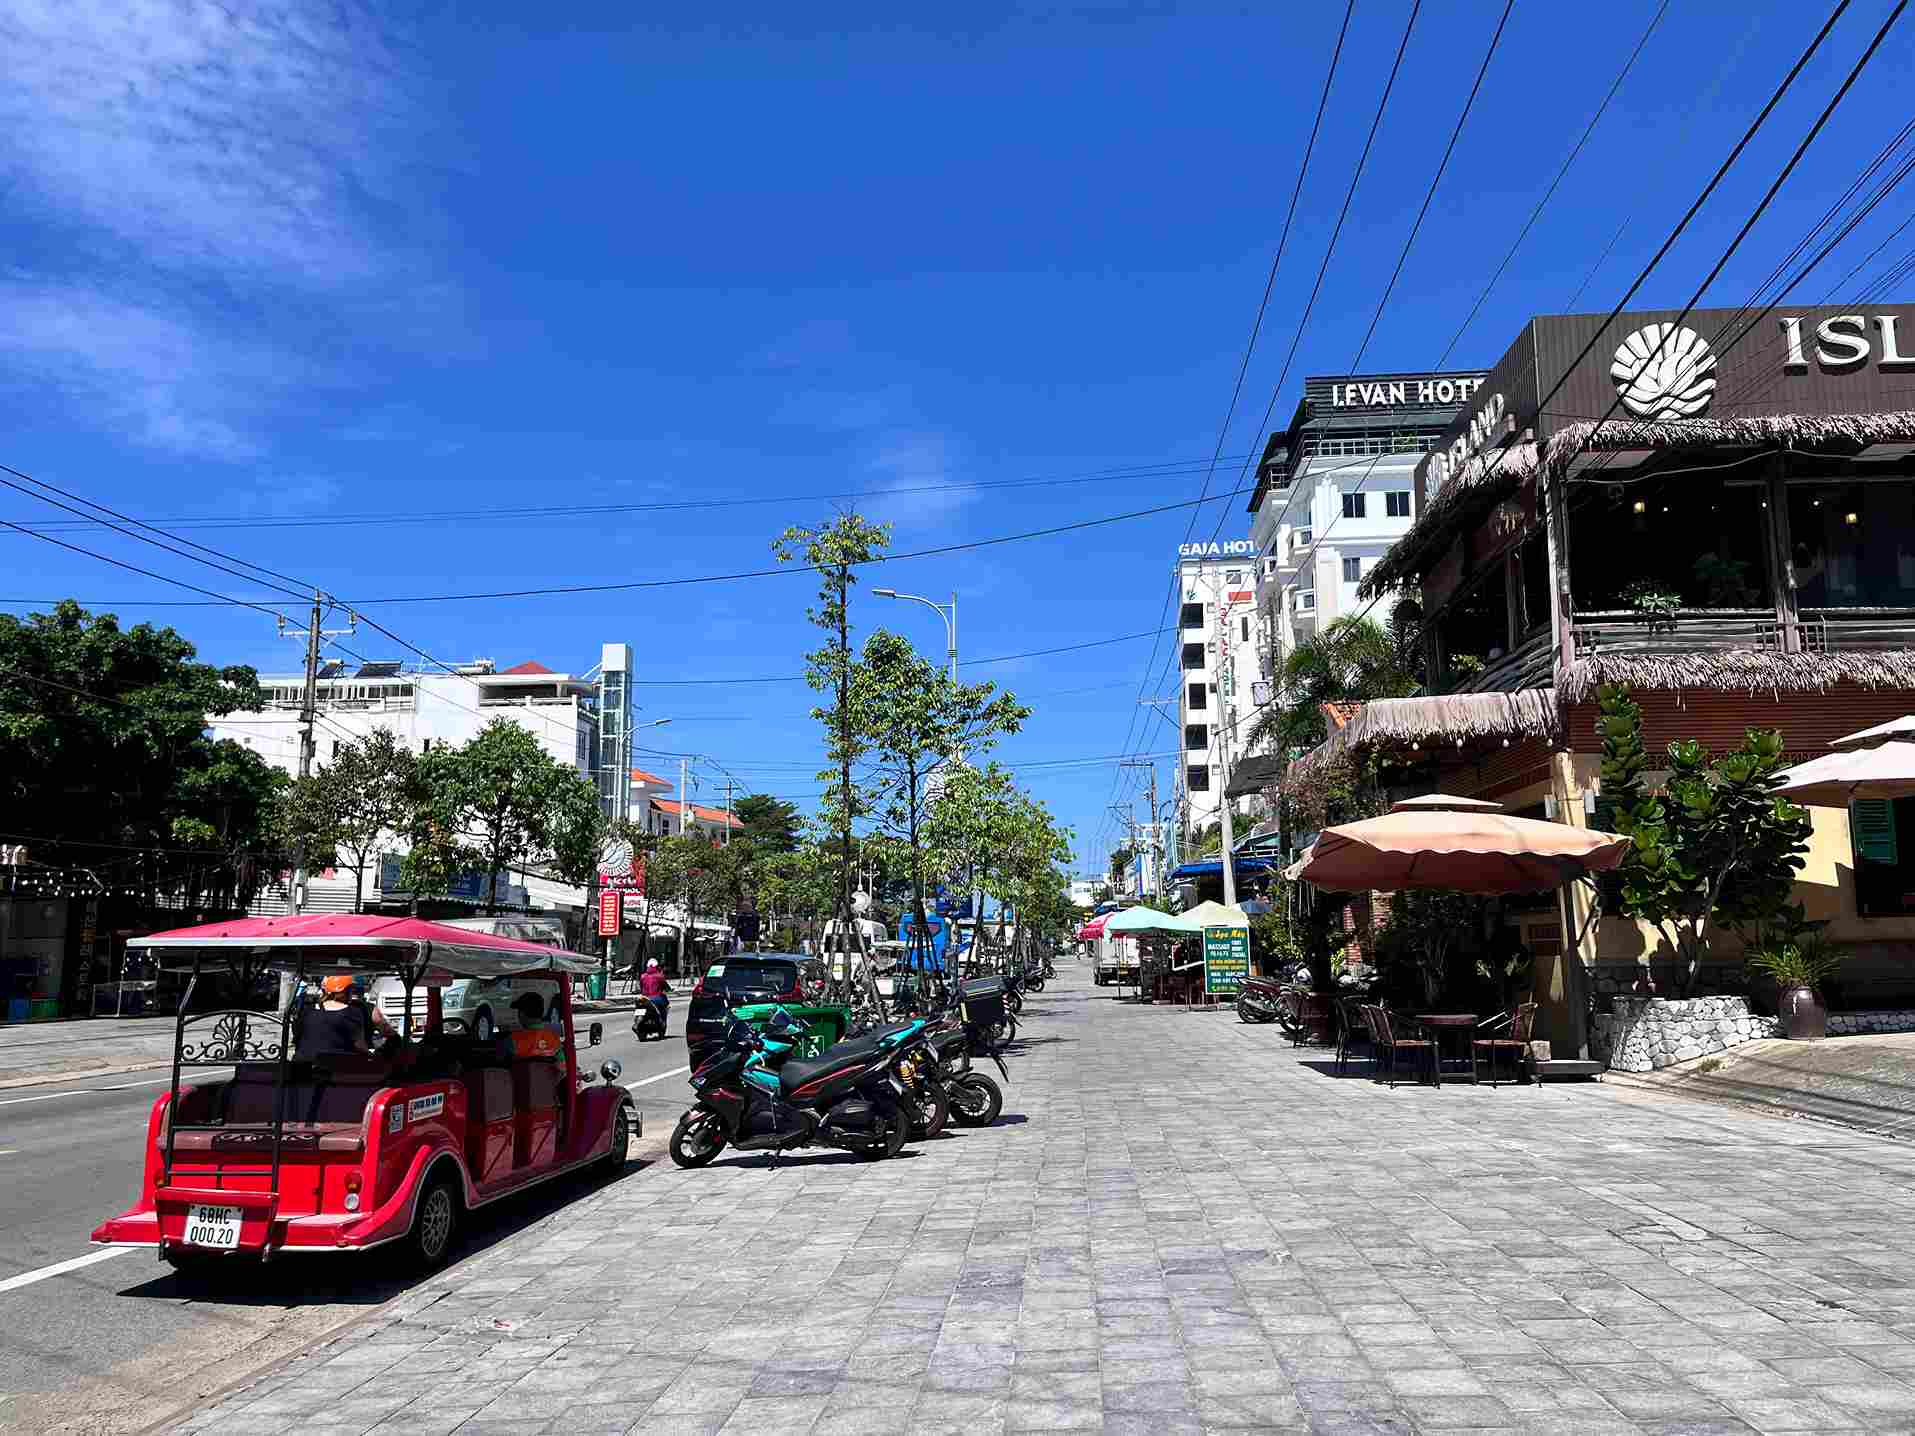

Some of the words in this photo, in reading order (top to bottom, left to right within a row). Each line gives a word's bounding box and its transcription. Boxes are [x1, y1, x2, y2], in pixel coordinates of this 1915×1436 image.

[1332, 383, 1406, 407] LEVAN
[1178, 542, 1220, 556] GAIA
[200, 1206, 231, 1225] 68HC
[190, 1226, 234, 1244] 000.20
